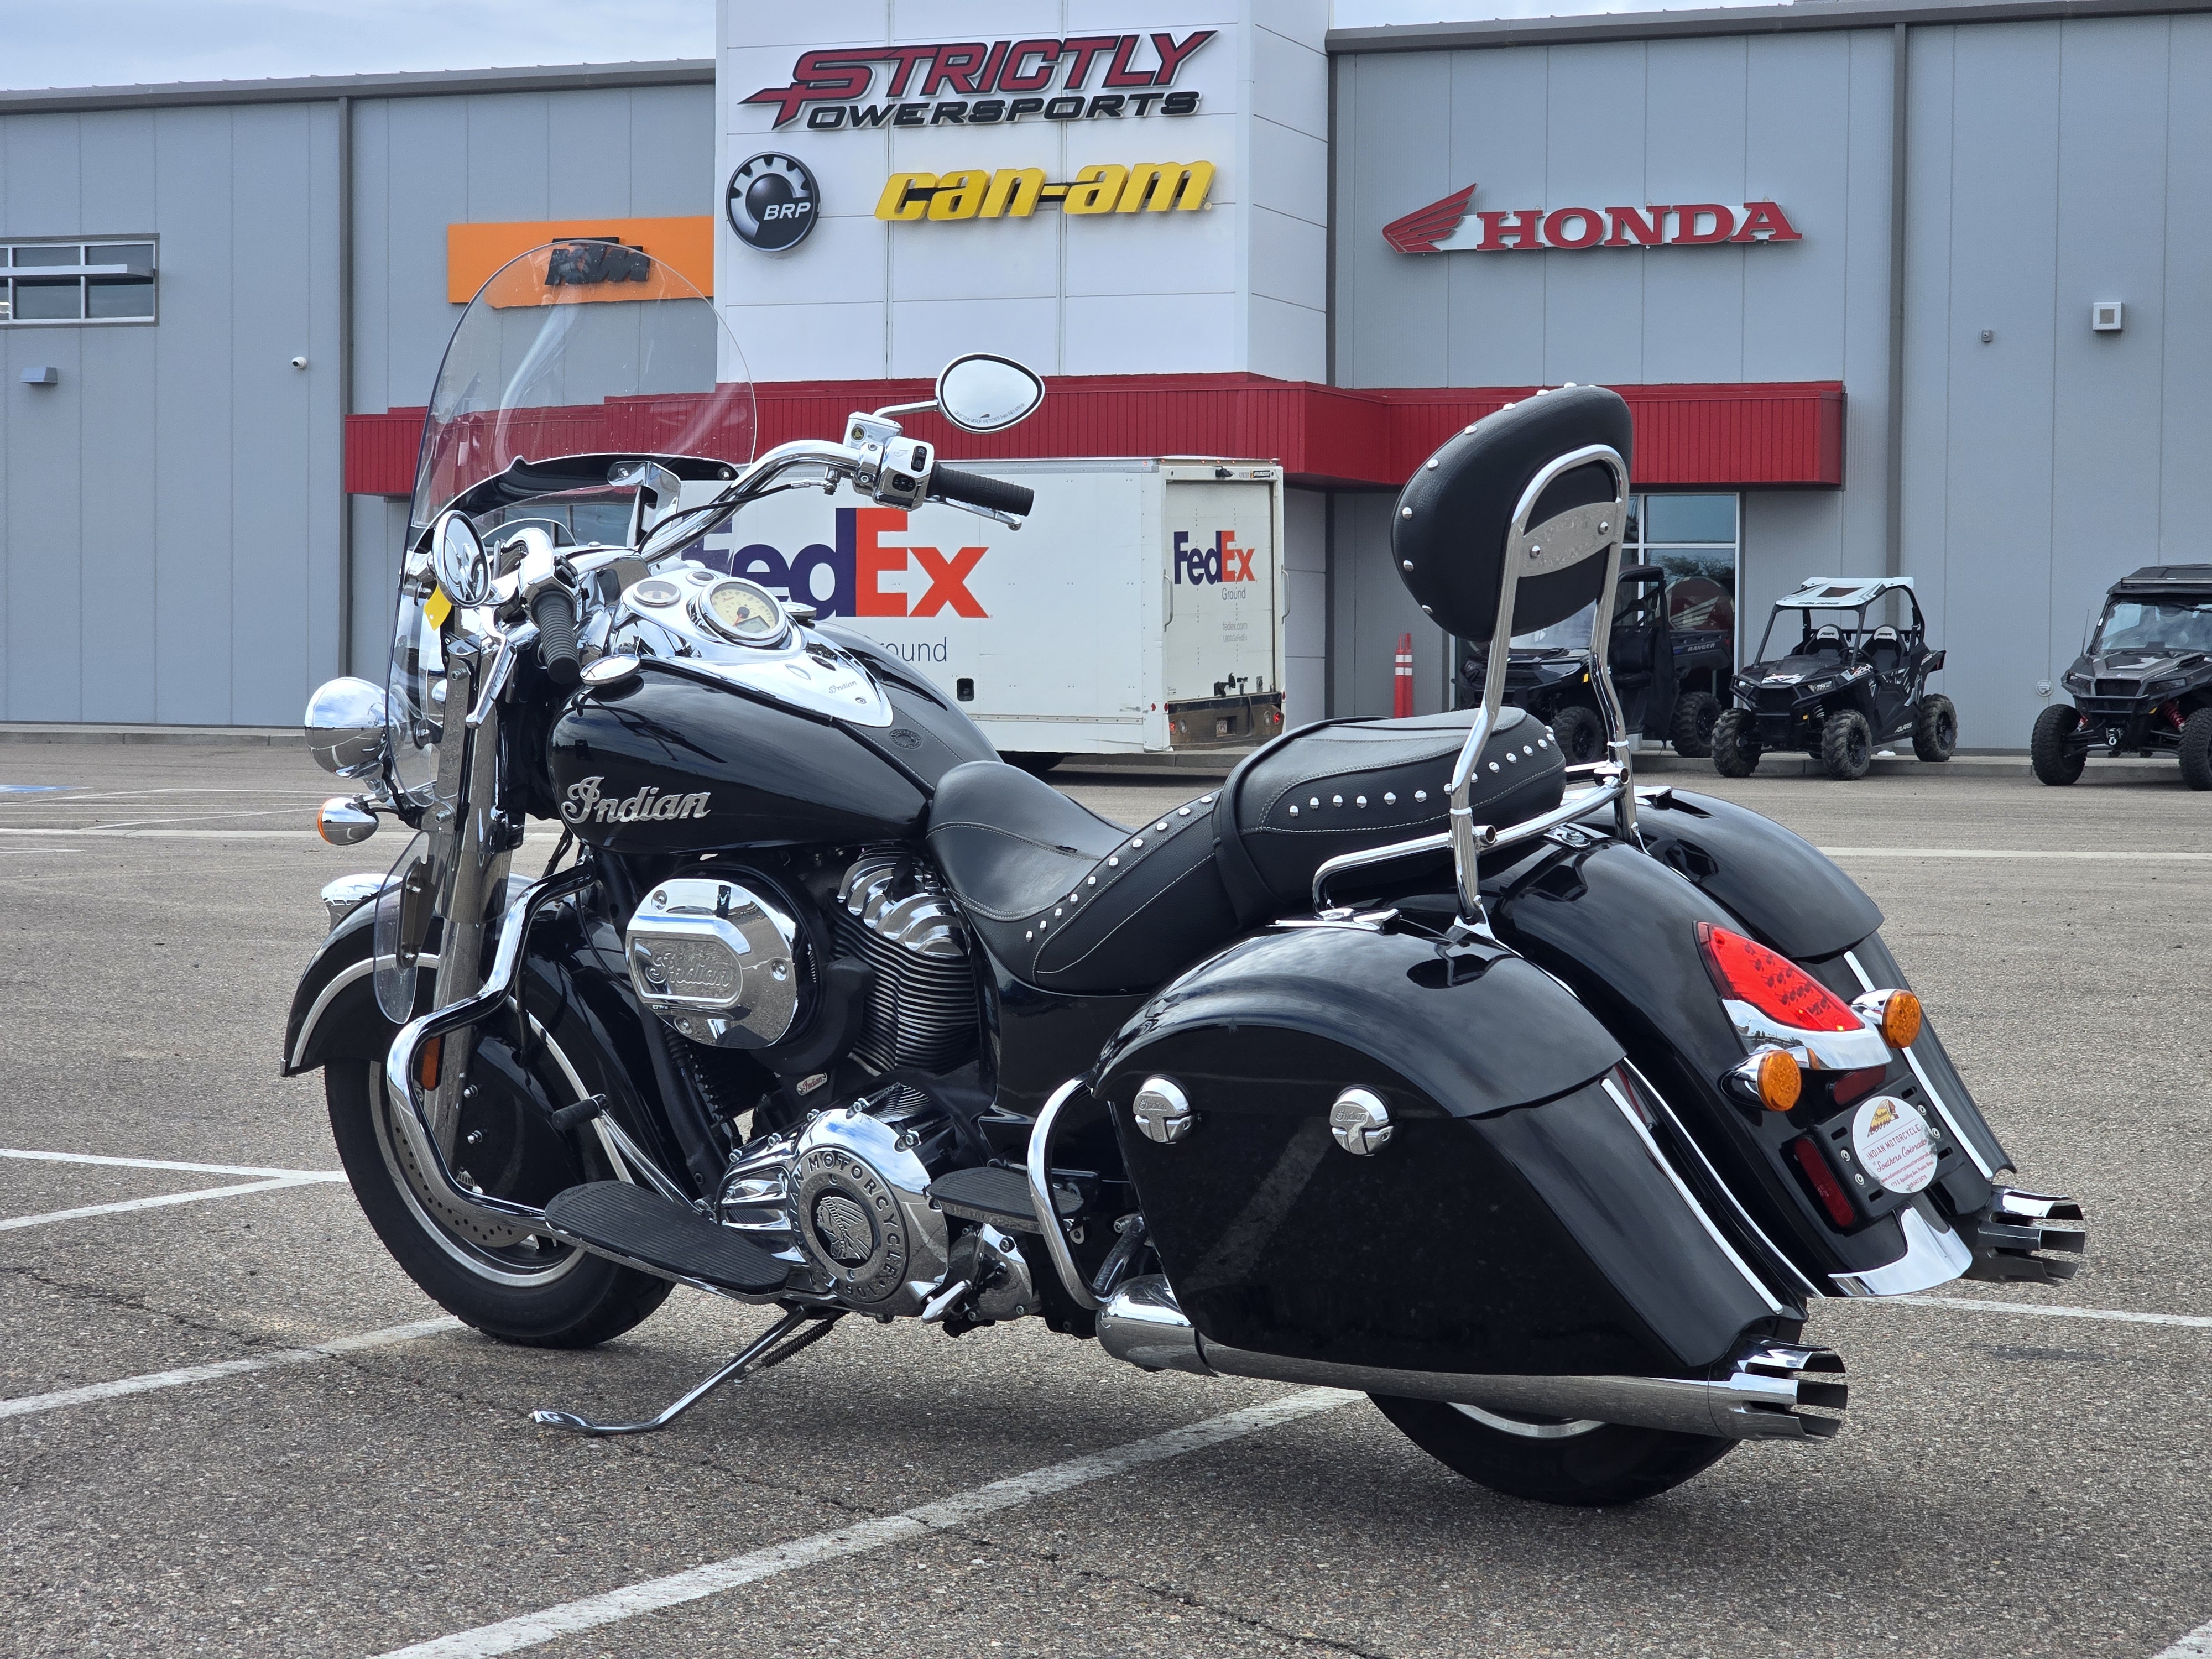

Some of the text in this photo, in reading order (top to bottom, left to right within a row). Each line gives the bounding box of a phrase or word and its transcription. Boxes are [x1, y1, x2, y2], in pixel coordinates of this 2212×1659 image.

[739, 31, 1218, 102] STRICTLY
[874, 160, 1215, 222] can-am
[764, 202, 811, 220] BRP
[1476, 201, 1803, 251] HONDA
[681, 508, 990, 620] FedEx
[1173, 530, 1255, 585] FedEx
[1222, 587, 1246, 601] Ground
[1223, 621, 1248, 631] fedex.com
[880, 637, 947, 662] ound
[1687, 643, 1715, 652] RANGER
[828, 680, 858, 694] Indian
[561, 776, 711, 823] Indian
[645, 953, 730, 987] Indian
[802, 1076, 823, 1092] Indian
[1139, 1098, 1167, 1112] Indian
[1335, 1109, 1365, 1123] Indian
[1866, 1123, 1921, 1161] INDIAN MOTORCYCLE
[1877, 1154, 1902, 1172] Southern
[1901, 1138, 1928, 1158] Colorado
[807, 1151, 901, 1278] MOTORCYCLE
